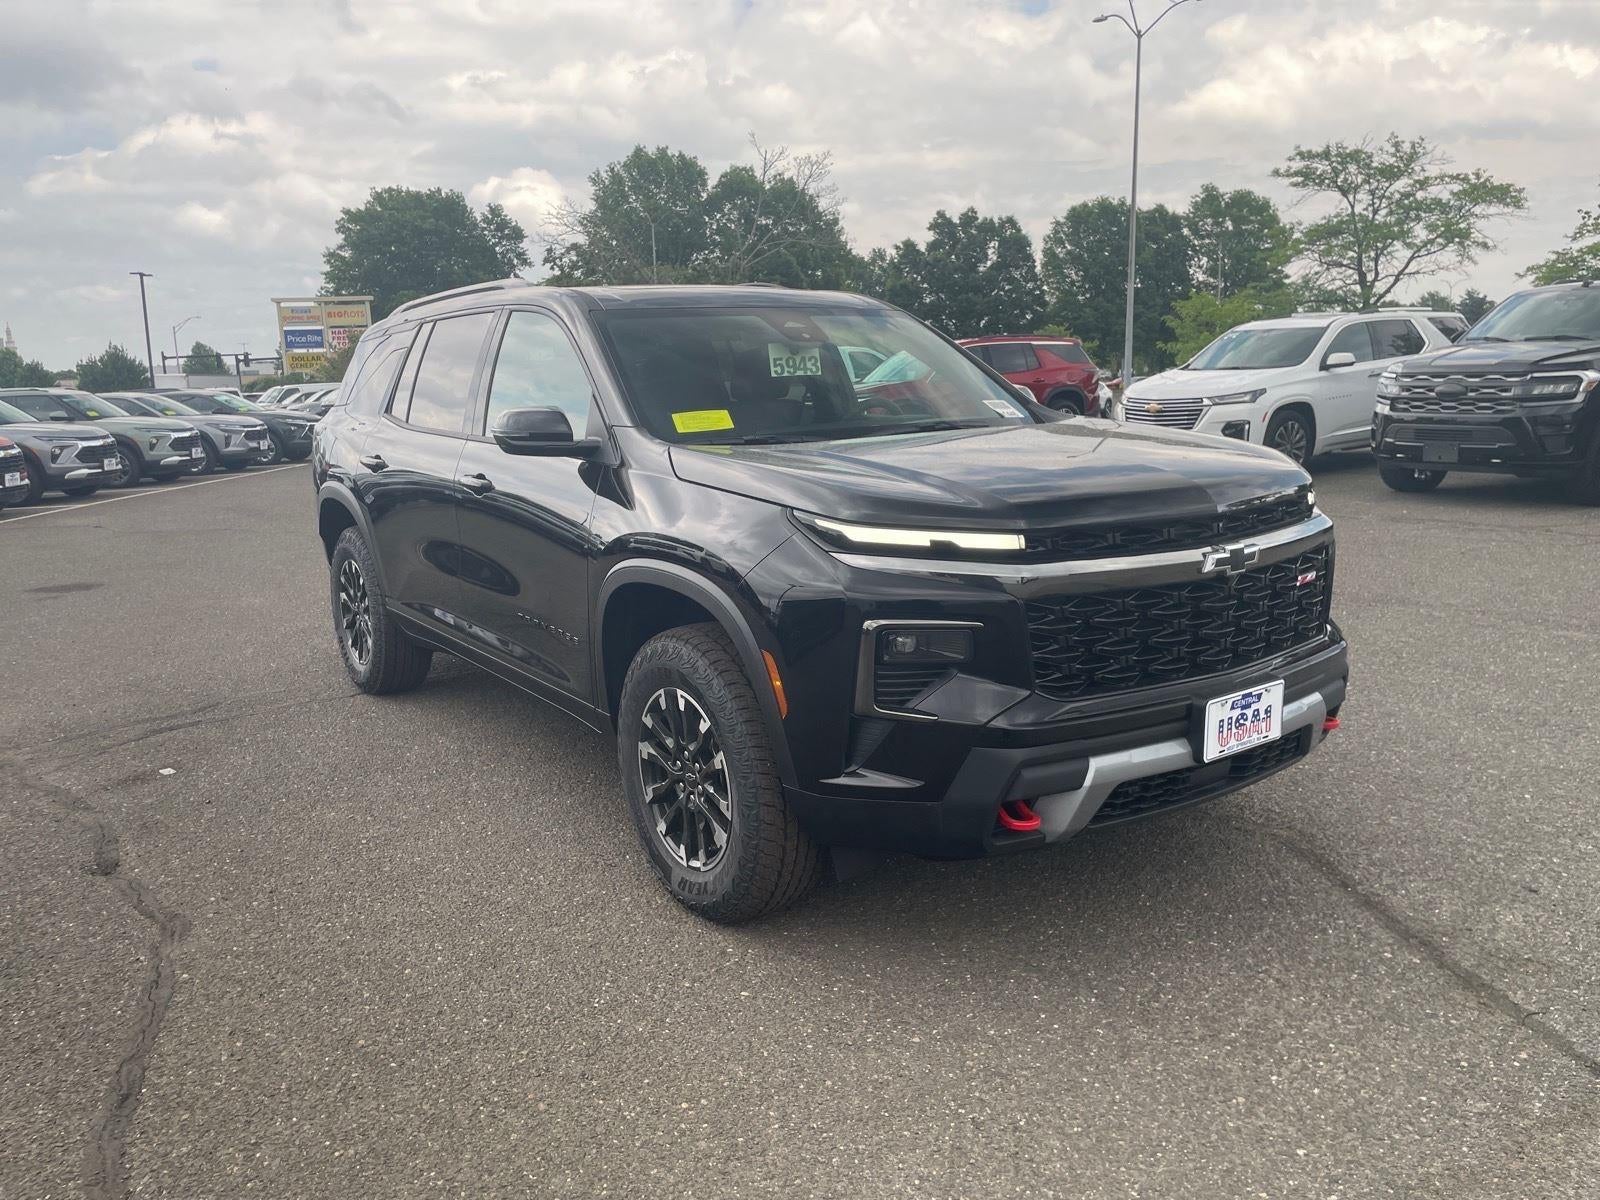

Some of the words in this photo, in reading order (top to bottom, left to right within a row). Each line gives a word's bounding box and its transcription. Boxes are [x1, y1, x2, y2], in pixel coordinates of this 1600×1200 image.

[287, 335, 306, 343] Price
[307, 334, 322, 343] Rite
[772, 355, 820, 376] 5943
[1233, 694, 1260, 708] CENTRAL
